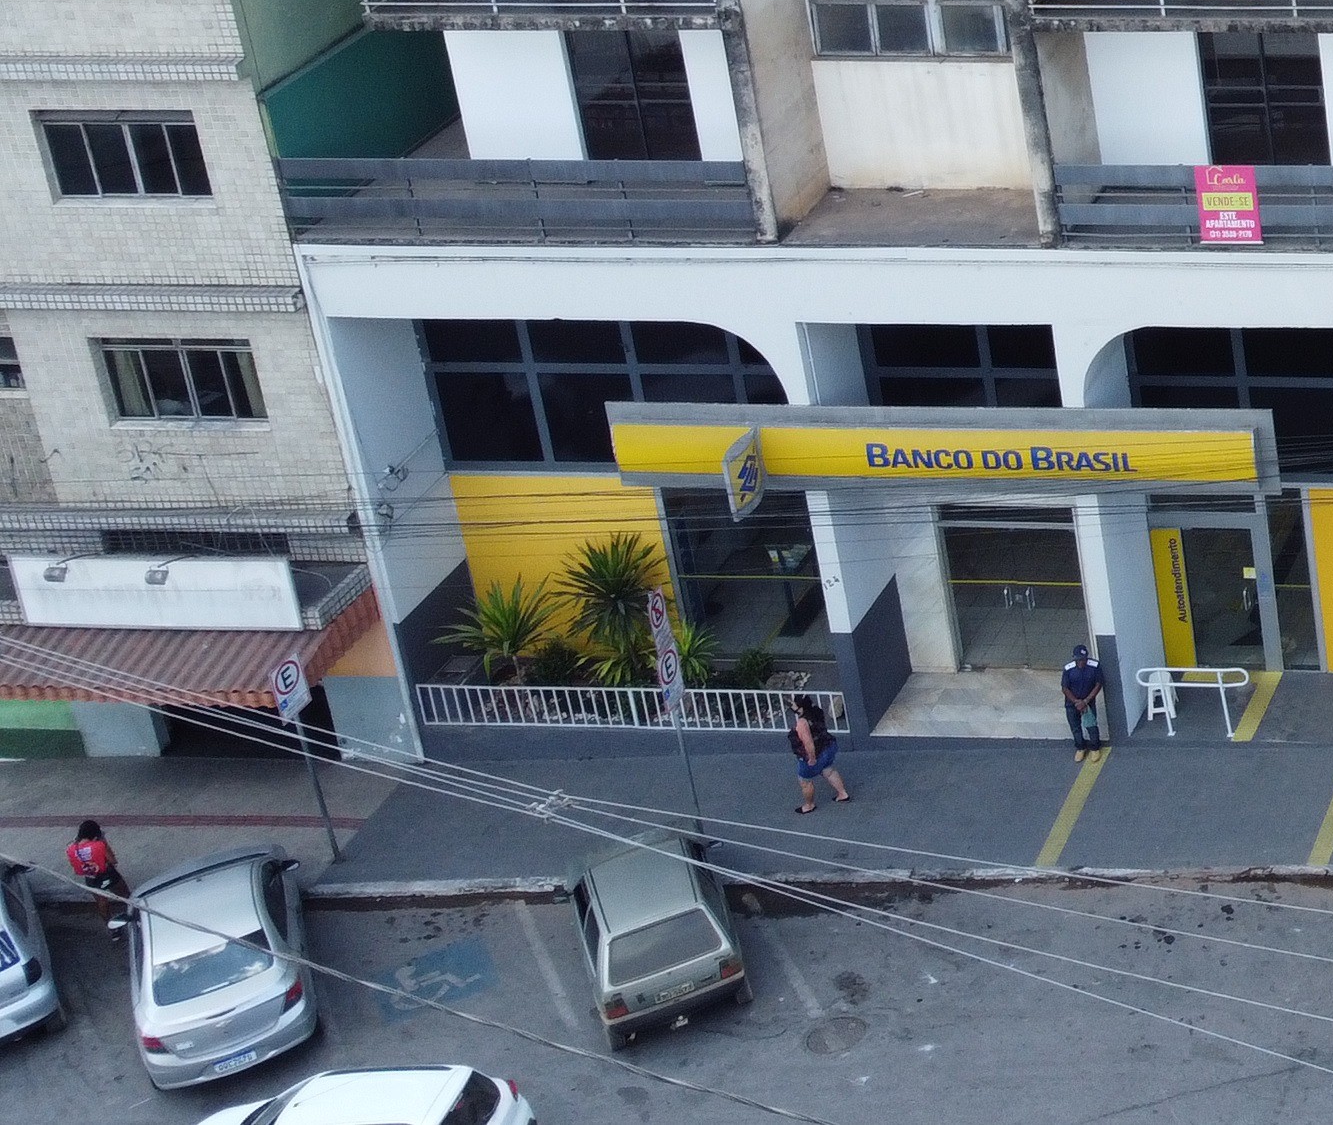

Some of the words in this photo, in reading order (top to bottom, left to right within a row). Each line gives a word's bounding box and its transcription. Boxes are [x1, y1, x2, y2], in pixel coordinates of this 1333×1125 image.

[1206, 196, 1249, 206] VENDE-SE
[1205, 220, 1256, 229] APARTAMENTO
[1219, 212, 1237, 220] ESTE
[1168, 538, 1188, 624] Autoatendimento
[665, 656, 674, 680] E
[281, 666, 295, 690] E
